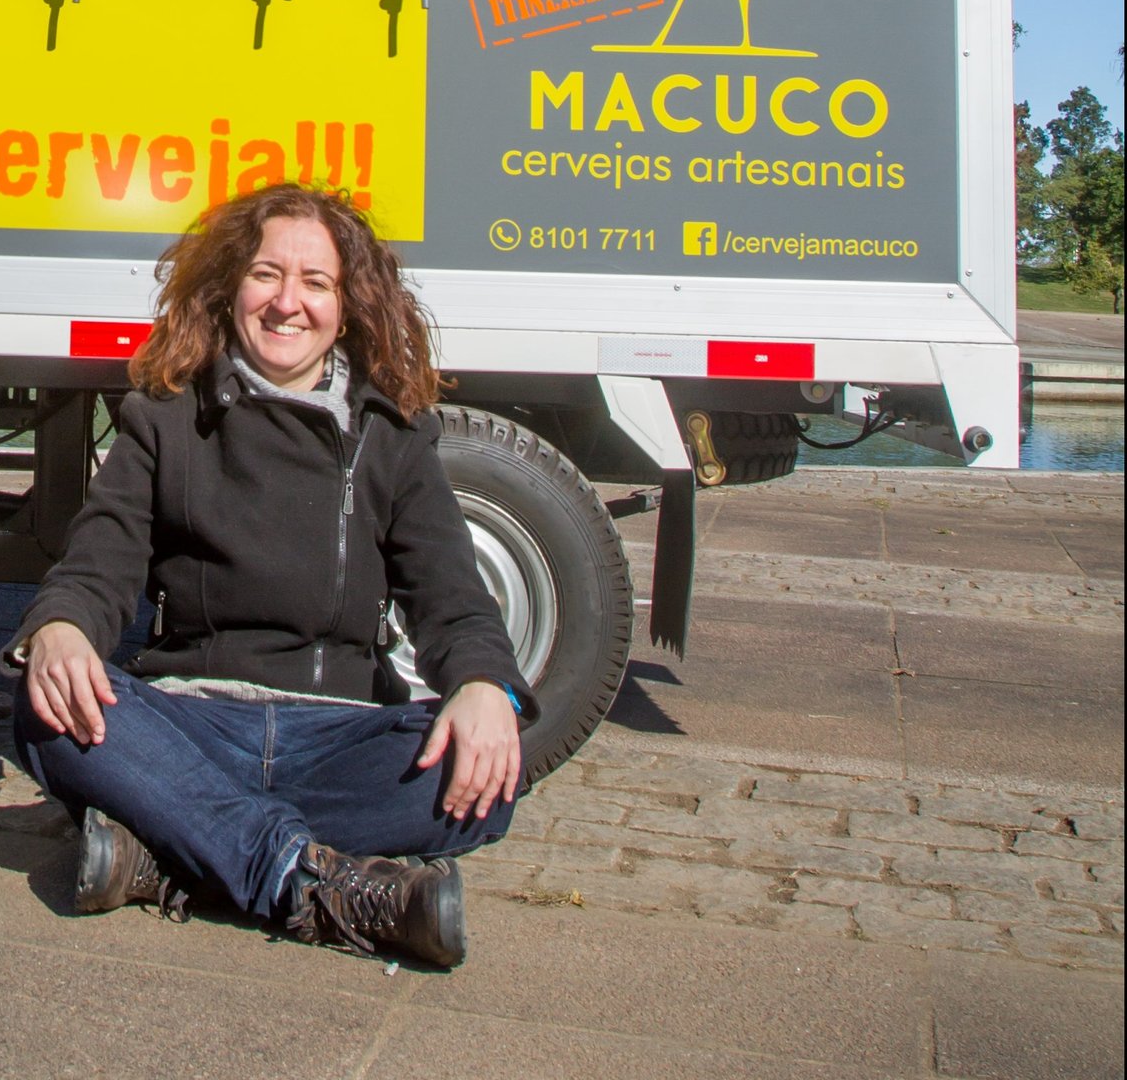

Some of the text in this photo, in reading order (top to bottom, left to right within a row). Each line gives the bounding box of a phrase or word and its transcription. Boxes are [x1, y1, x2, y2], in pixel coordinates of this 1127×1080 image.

[530, 70, 889, 139] MACUCO
[501, 142, 906, 190] cervejas artesanais
[529, 226, 588, 250] 8101
[599, 227, 656, 251] 7711
[723, 230, 920, 260] /cervejamacuco
